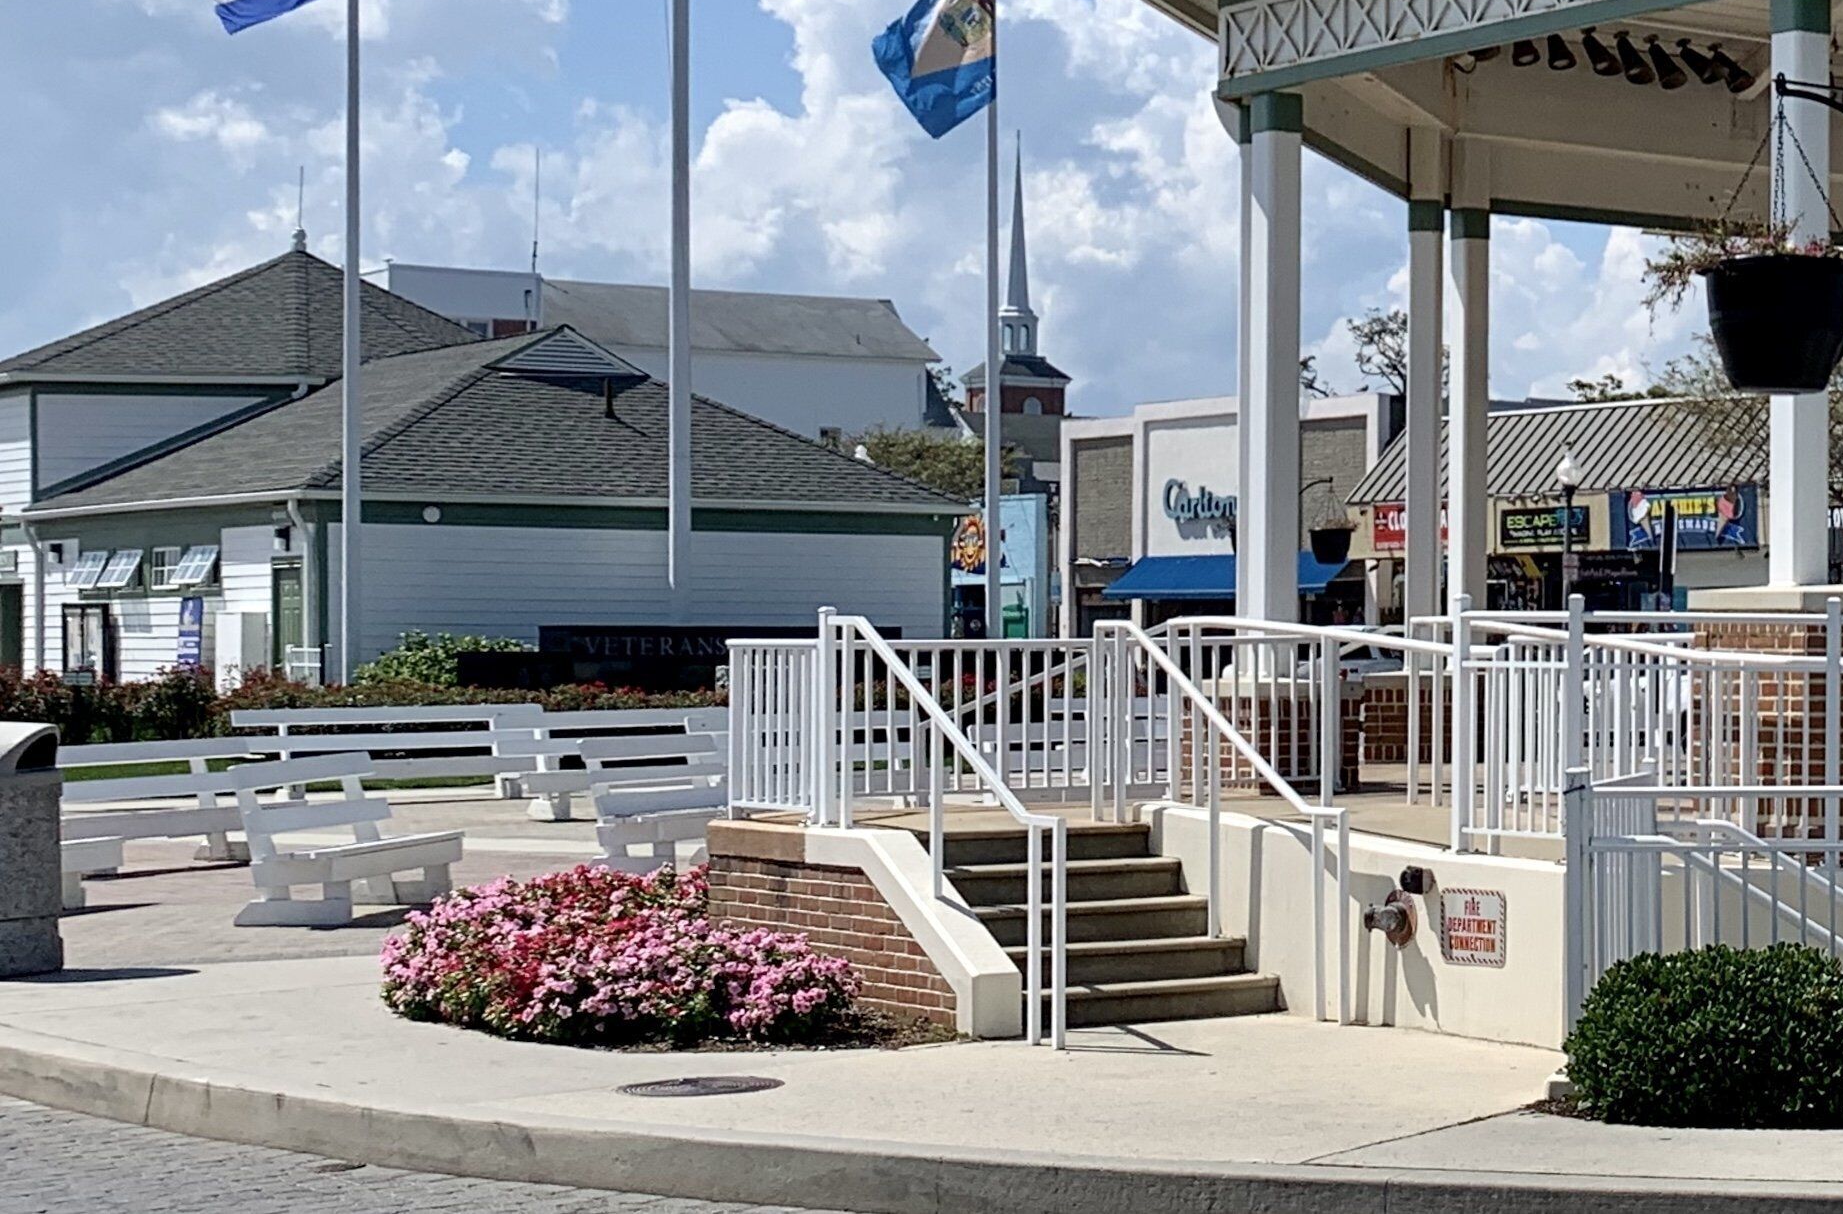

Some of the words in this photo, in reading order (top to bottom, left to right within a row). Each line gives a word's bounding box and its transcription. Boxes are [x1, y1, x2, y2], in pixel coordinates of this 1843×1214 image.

[1654, 517, 1717, 537] HEMADE
[584, 636, 728, 656] VETERANS
[1464, 900, 1481, 916] FIRE
[1448, 917, 1497, 935] DEPARTMENT
[1450, 934, 1496, 953] CONNECTION
